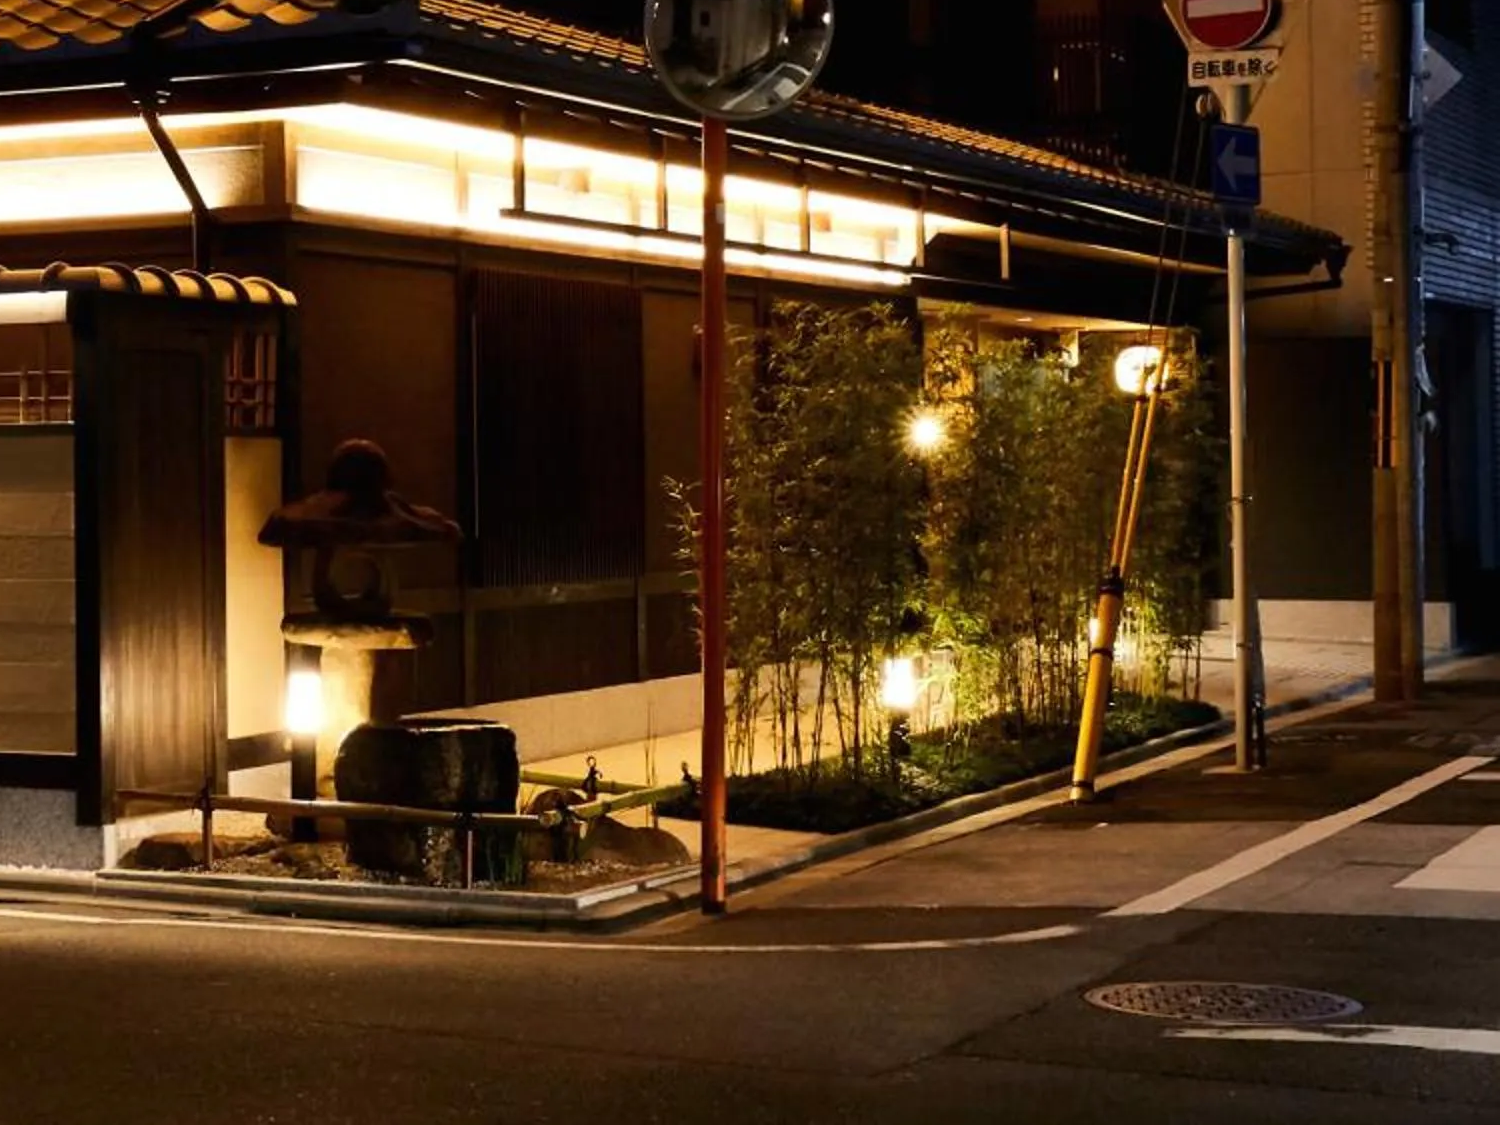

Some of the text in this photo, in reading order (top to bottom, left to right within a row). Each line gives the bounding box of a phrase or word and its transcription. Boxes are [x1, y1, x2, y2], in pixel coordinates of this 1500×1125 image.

[1192, 58, 1278, 79] 自転車を除く
